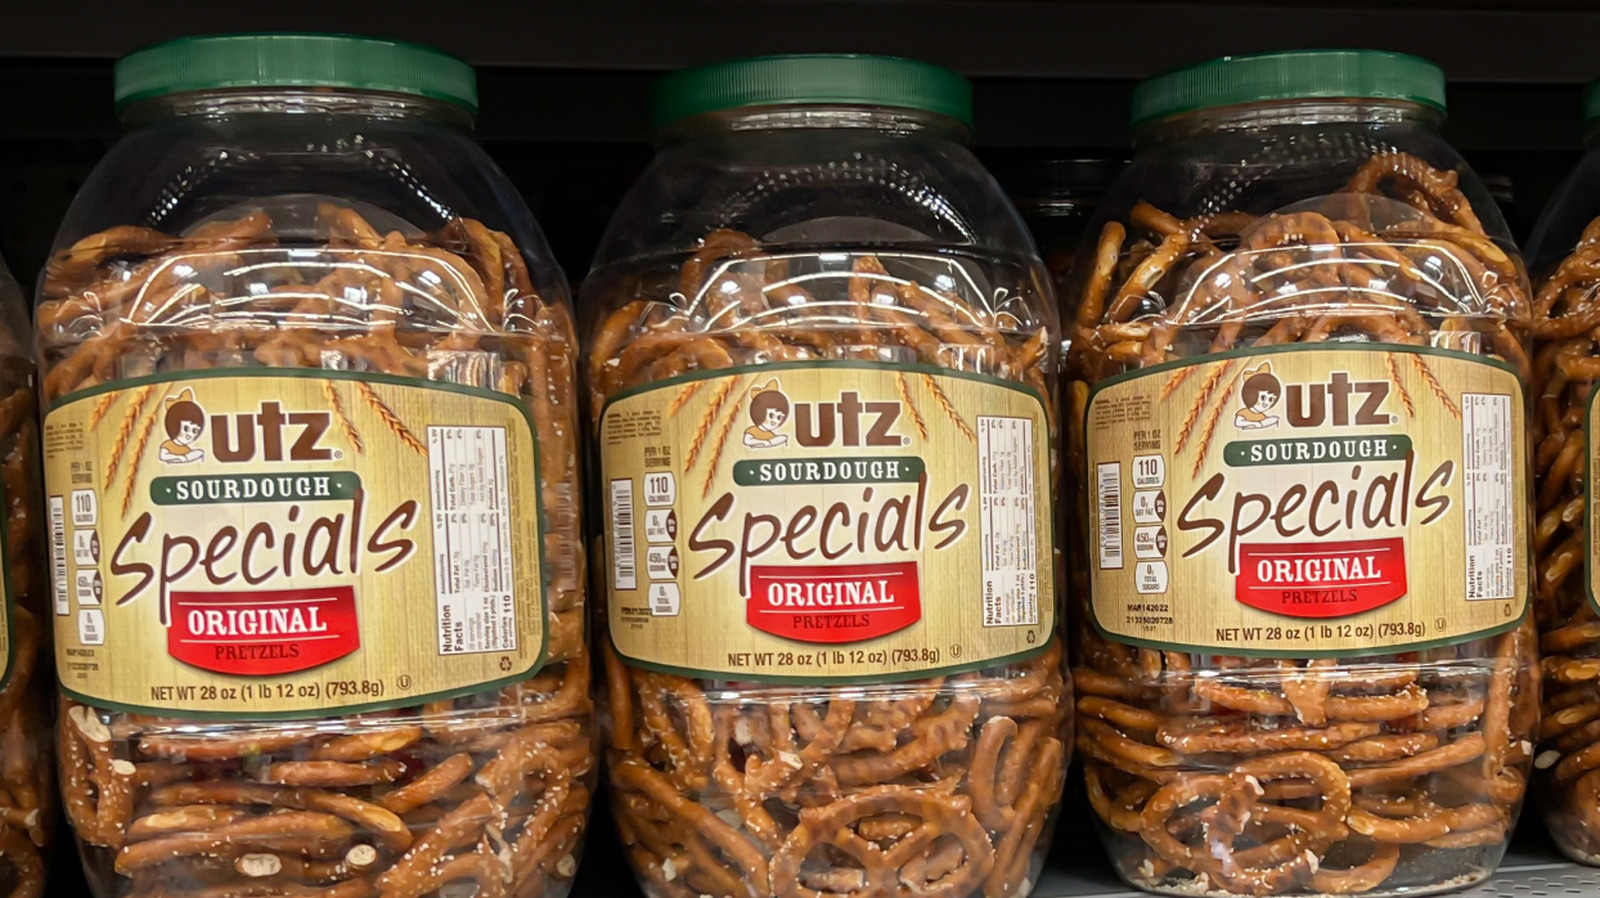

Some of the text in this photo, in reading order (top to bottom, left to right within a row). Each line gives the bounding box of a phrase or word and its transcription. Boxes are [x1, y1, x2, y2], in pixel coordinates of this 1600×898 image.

[1286, 372, 1390, 428] utz
[794, 392, 902, 447] utz
[210, 401, 333, 463] utz
[1134, 430, 1146, 440] PER
[1152, 430, 1161, 439] OZ
[1134, 440, 1161, 451] SERVING
[1250, 440, 1388, 462] SOURDOUGH
[760, 461, 900, 482] SOURDOUGH
[1138, 459, 1157, 476] 110
[176, 477, 330, 499] SOURDOUGH
[650, 476, 668, 494] 110
[76, 494, 91, 512] 110
[1177, 450, 1454, 574] Specials
[688, 471, 969, 597] Specials
[110, 488, 418, 625] Specials
[1257, 556, 1382, 582] ORIGINAL
[503, 595, 511, 612] 110
[768, 580, 894, 606] ORIGINAL
[985, 581, 993, 624] Nutrition
[1282, 589, 1358, 604] PRETZELS
[188, 607, 327, 635] ORIGINAL
[441, 605, 452, 652] Nutrition
[793, 614, 870, 628] PRETZELS
[1216, 622, 1426, 642] NET WT 28 oz (1 lb 12 oz) (793.8g)
[454, 622, 463, 651] Facts
[214, 644, 300, 660] PRETZELS
[728, 648, 940, 668] NET WT 28 oz (1 lb 12 oz) (793.8g)
[151, 680, 384, 702] NET WT 28 oz (1 lb 12 oz) (793.8g)
